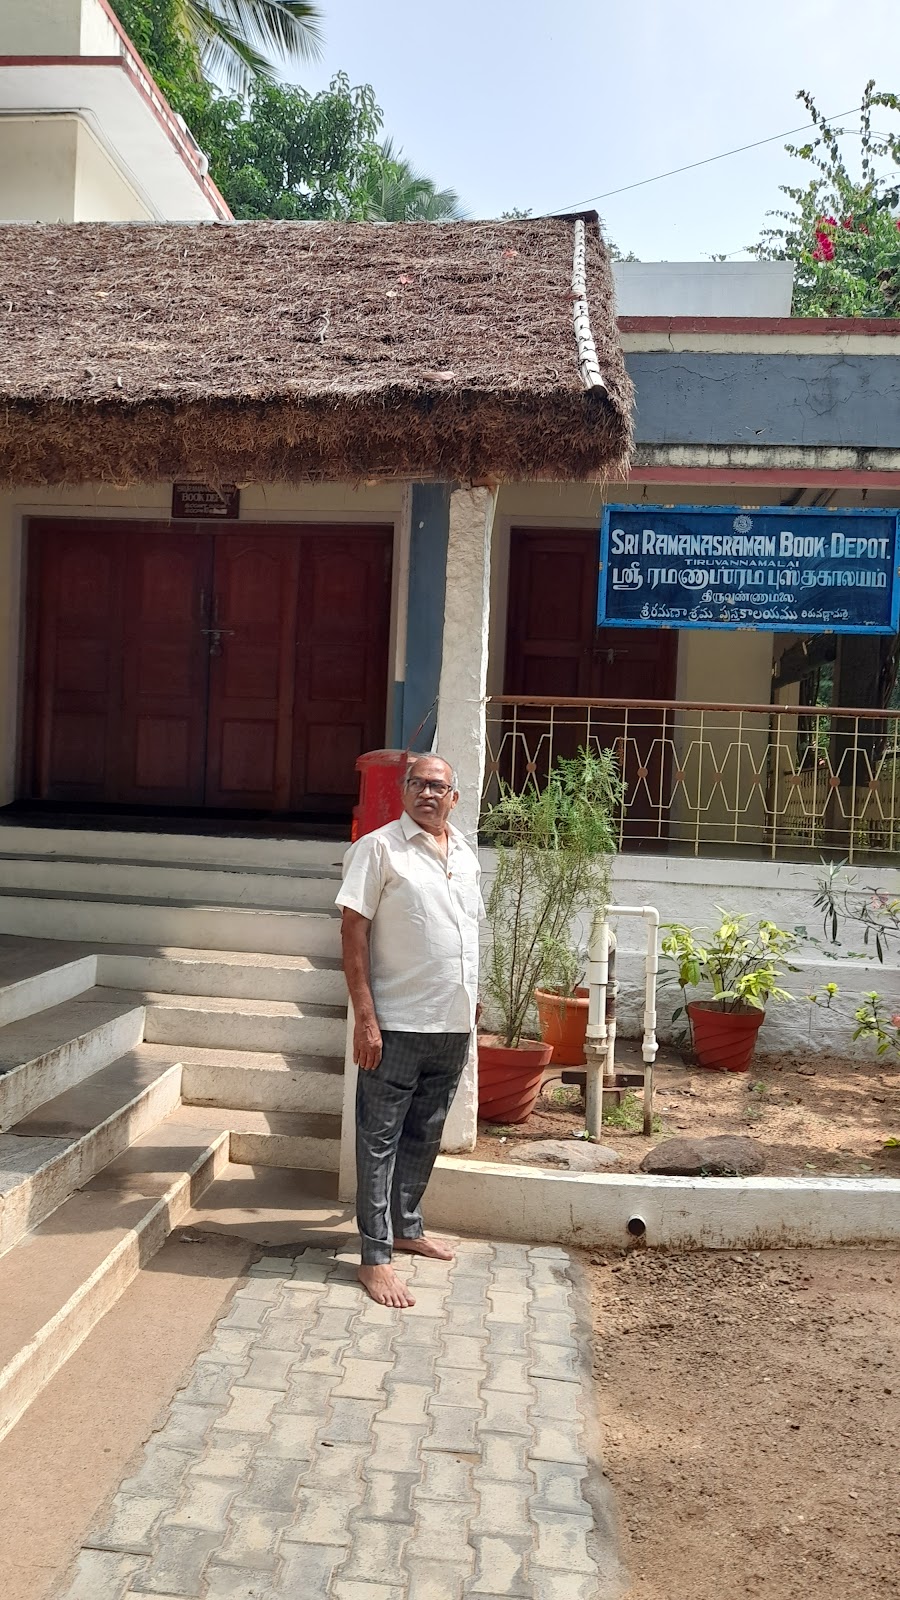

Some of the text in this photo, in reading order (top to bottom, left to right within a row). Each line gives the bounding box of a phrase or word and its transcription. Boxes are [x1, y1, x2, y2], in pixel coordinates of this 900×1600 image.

[181, 493, 231, 504] BOOK DEPT
[611, 528, 639, 555] SRI
[642, 529, 776, 557] RAMANASRAMAM
[684, 558, 799, 568] TIRUVANNAMALAI
